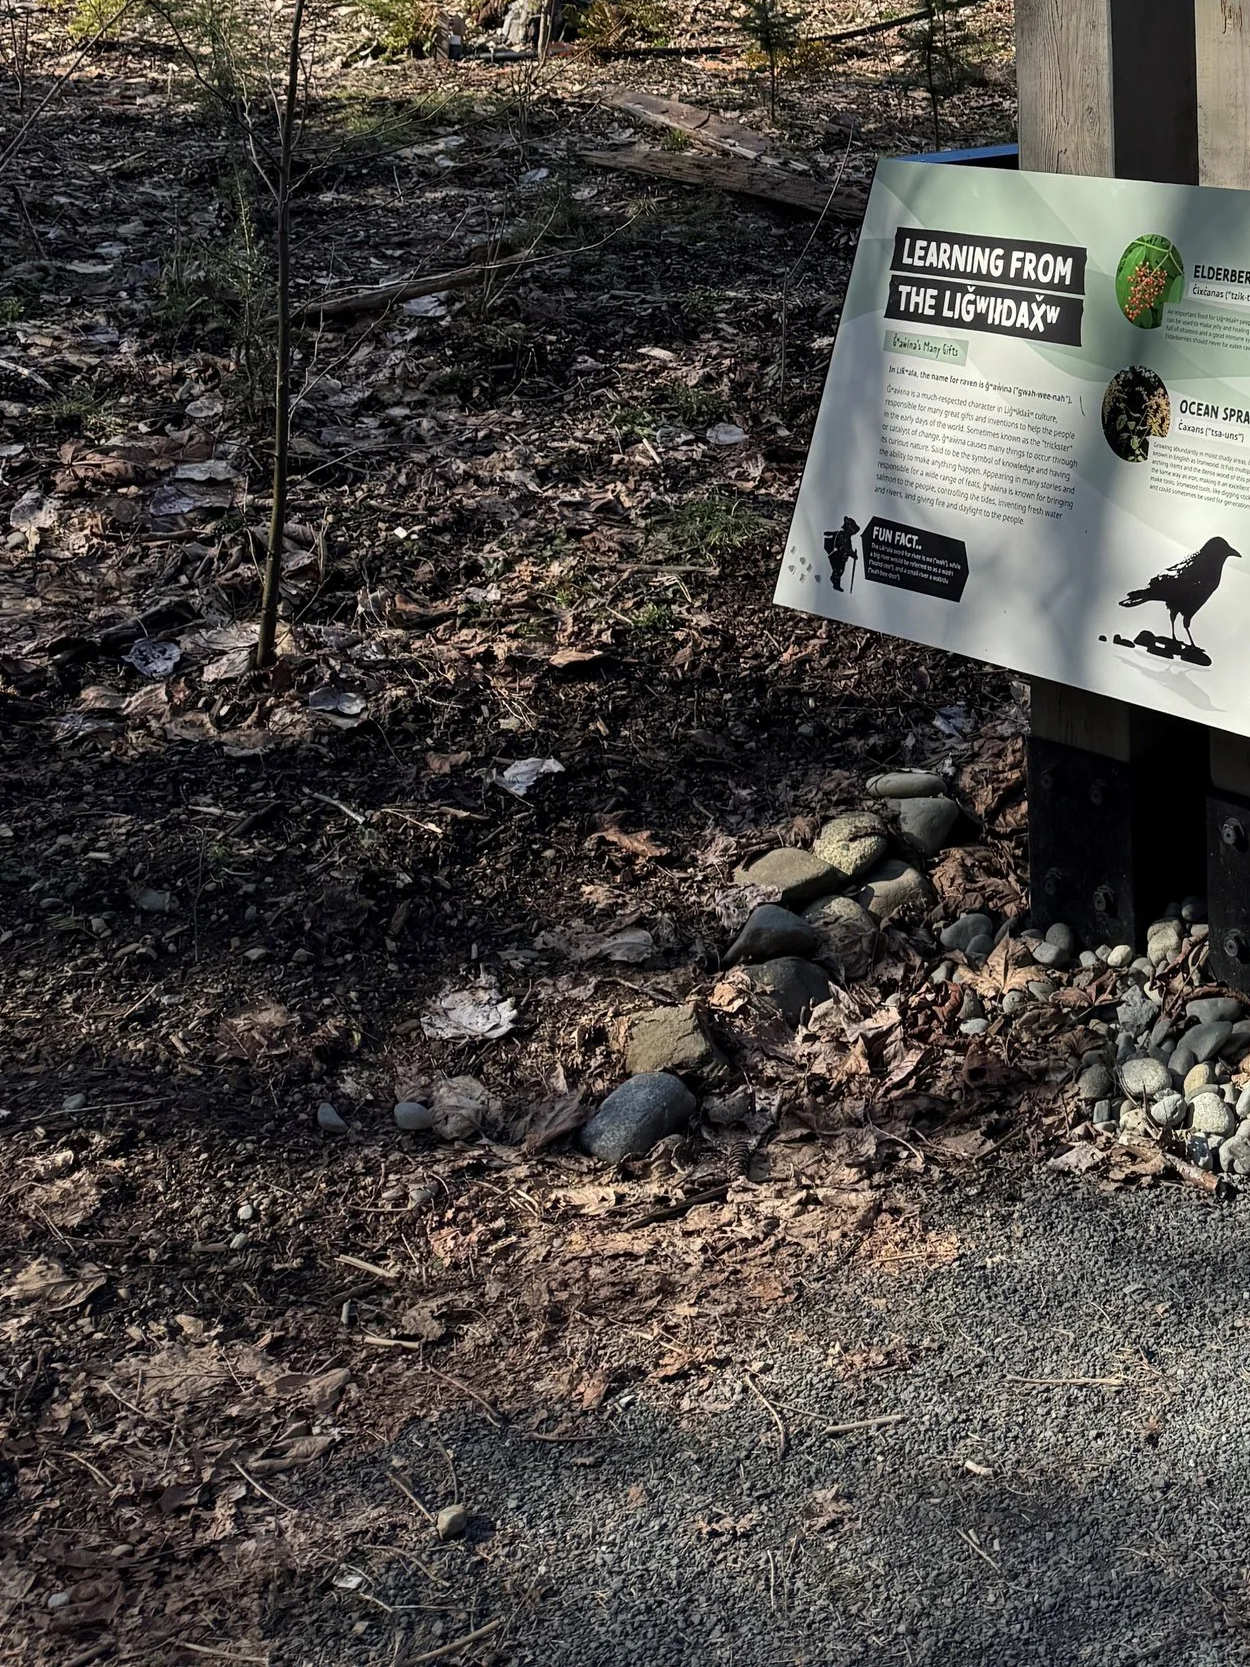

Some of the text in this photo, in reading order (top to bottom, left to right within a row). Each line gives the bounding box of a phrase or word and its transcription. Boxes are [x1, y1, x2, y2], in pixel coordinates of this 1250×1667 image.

[902, 238, 1073, 286] LEARNING FROM
[898, 285, 938, 315] THE
[921, 340, 941, 358] Many
[941, 343, 959, 356] Gifts
[919, 370, 930, 379] the
[931, 374, 948, 382] name
[949, 375, 958, 383] for
[959, 379, 977, 387] raven
[978, 380, 984, 388] is
[884, 399, 916, 409] responsible
[917, 402, 926, 411] for
[926, 406, 943, 416] many
[943, 409, 960, 417] great
[960, 411, 974, 420] gifts
[974, 414, 986, 422] and
[987, 415, 1018, 428] inventions
[1027, 422, 1040, 434] help
[1041, 425, 1052, 434] the
[1053, 429, 1075, 440] people
[967, 400, 995, 411] character
[1179, 398, 1218, 419] OCEAN
[889, 411, 899, 419] the
[900, 414, 913, 424] early
[914, 415, 928, 426] days
[936, 419, 946, 428] the
[966, 425, 999, 438] Sometimes
[1000, 431, 1020, 442] known
[1030, 437, 1040, 446] the
[878, 446, 888, 455] the
[914, 455, 930, 464] make
[930, 459, 956, 472] anything
[957, 462, 981, 475] happen.
[982, 467, 1013, 483] Appearing
[1022, 478, 1039, 489] many
[1040, 480, 1061, 491] stories
[1062, 485, 1075, 493] and
[888, 437, 909, 446] curious
[909, 441, 929, 451] nature.
[930, 444, 943, 453] Said
[960, 450, 970, 459] the
[971, 454, 993, 463] symbol
[1001, 458, 1034, 473] knowledge
[1035, 466, 1048, 474] and
[1048, 467, 1070, 481] having
[874, 486, 885, 494] and
[904, 492, 916, 500] and
[916, 494, 934, 507] giving
[946, 501, 958, 510] and
[958, 503, 982, 517] daylight
[991, 510, 1001, 520] the
[872, 526, 893, 543] FUN
